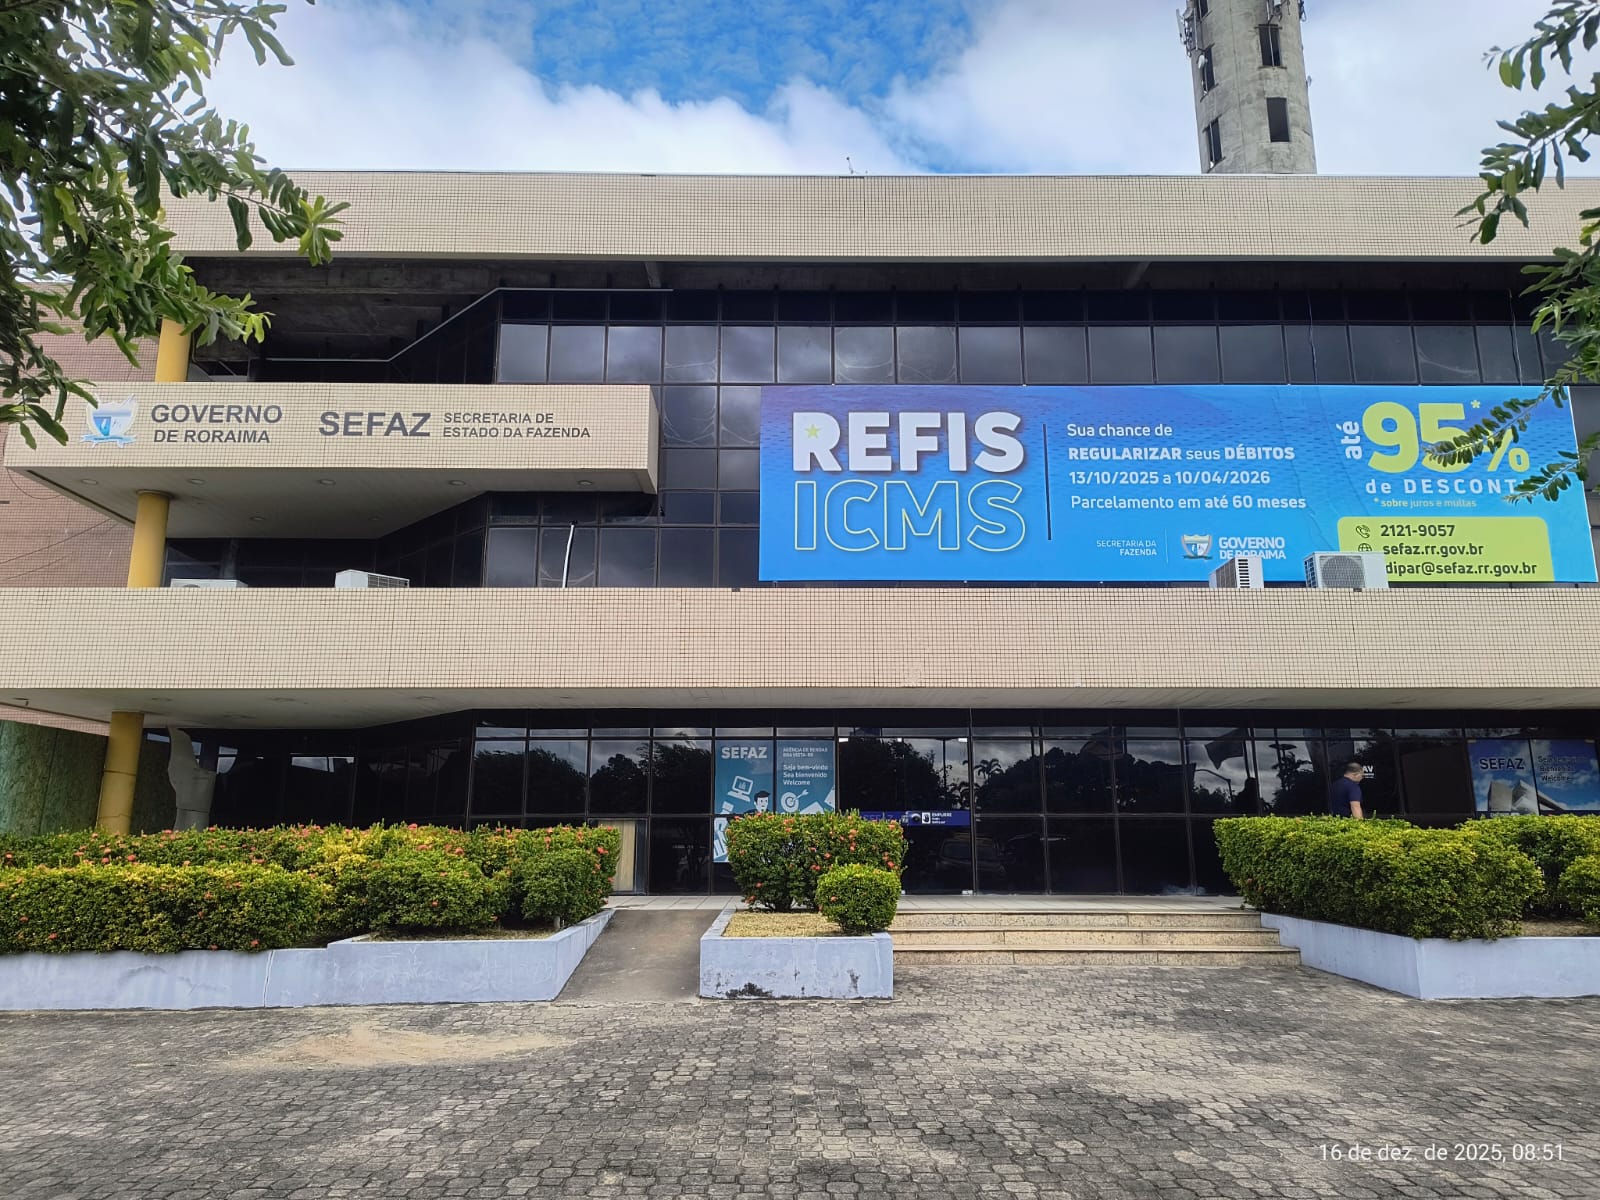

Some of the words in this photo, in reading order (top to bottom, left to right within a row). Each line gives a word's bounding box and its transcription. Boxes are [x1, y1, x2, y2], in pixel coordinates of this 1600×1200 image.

[151, 404, 282, 423] GOVERNO
[443, 412, 532, 424] SECRETARIA
[535, 412, 554, 424] DE
[318, 411, 431, 437] SEFAZ
[1067, 423, 1095, 437] Sua
[1098, 423, 1150, 437] chance
[1154, 423, 1173, 437] de
[153, 429, 178, 443] DE
[183, 429, 270, 443] RORAIMA
[443, 427, 499, 438] ESTADO
[502, 427, 522, 438] DA
[525, 427, 591, 438] FAZENDA
[792, 411, 1025, 473] REFIS
[1335, 420, 1362, 460] até
[1068, 447, 1182, 460] REGULARIZAR
[1185, 449, 1221, 460] seus
[1224, 443, 1296, 460] DÉBITOS
[1068, 470, 1159, 485] 13/10/2025
[1162, 474, 1172, 485] a
[1174, 470, 1271, 485] 10/04/2026
[1365, 478, 1392, 494] de
[1404, 478, 1523, 495] DESCONT
[1071, 495, 1174, 509] Parcelamento
[1177, 498, 1201, 509] em
[1204, 495, 1229, 509] até
[1232, 495, 1253, 509] 60
[1257, 498, 1307, 509] meses
[794, 479, 1026, 552] ICMS
[1380, 524, 1456, 537] 2121-9057
[1096, 539, 1143, 548] SECRETARIA
[1144, 539, 1157, 548] DA
[1218, 536, 1286, 549] GOVERNO
[1119, 548, 1157, 556] FAZENDA
[1219, 549, 1234, 560] DE
[1382, 543, 1484, 557] sefaz.rr.gov.br
[1385, 561, 1537, 577] dipar@sefaz.rr.gov.br
[721, 746, 767, 759] SEFAZ
[1479, 758, 1525, 770] SEFAZ
